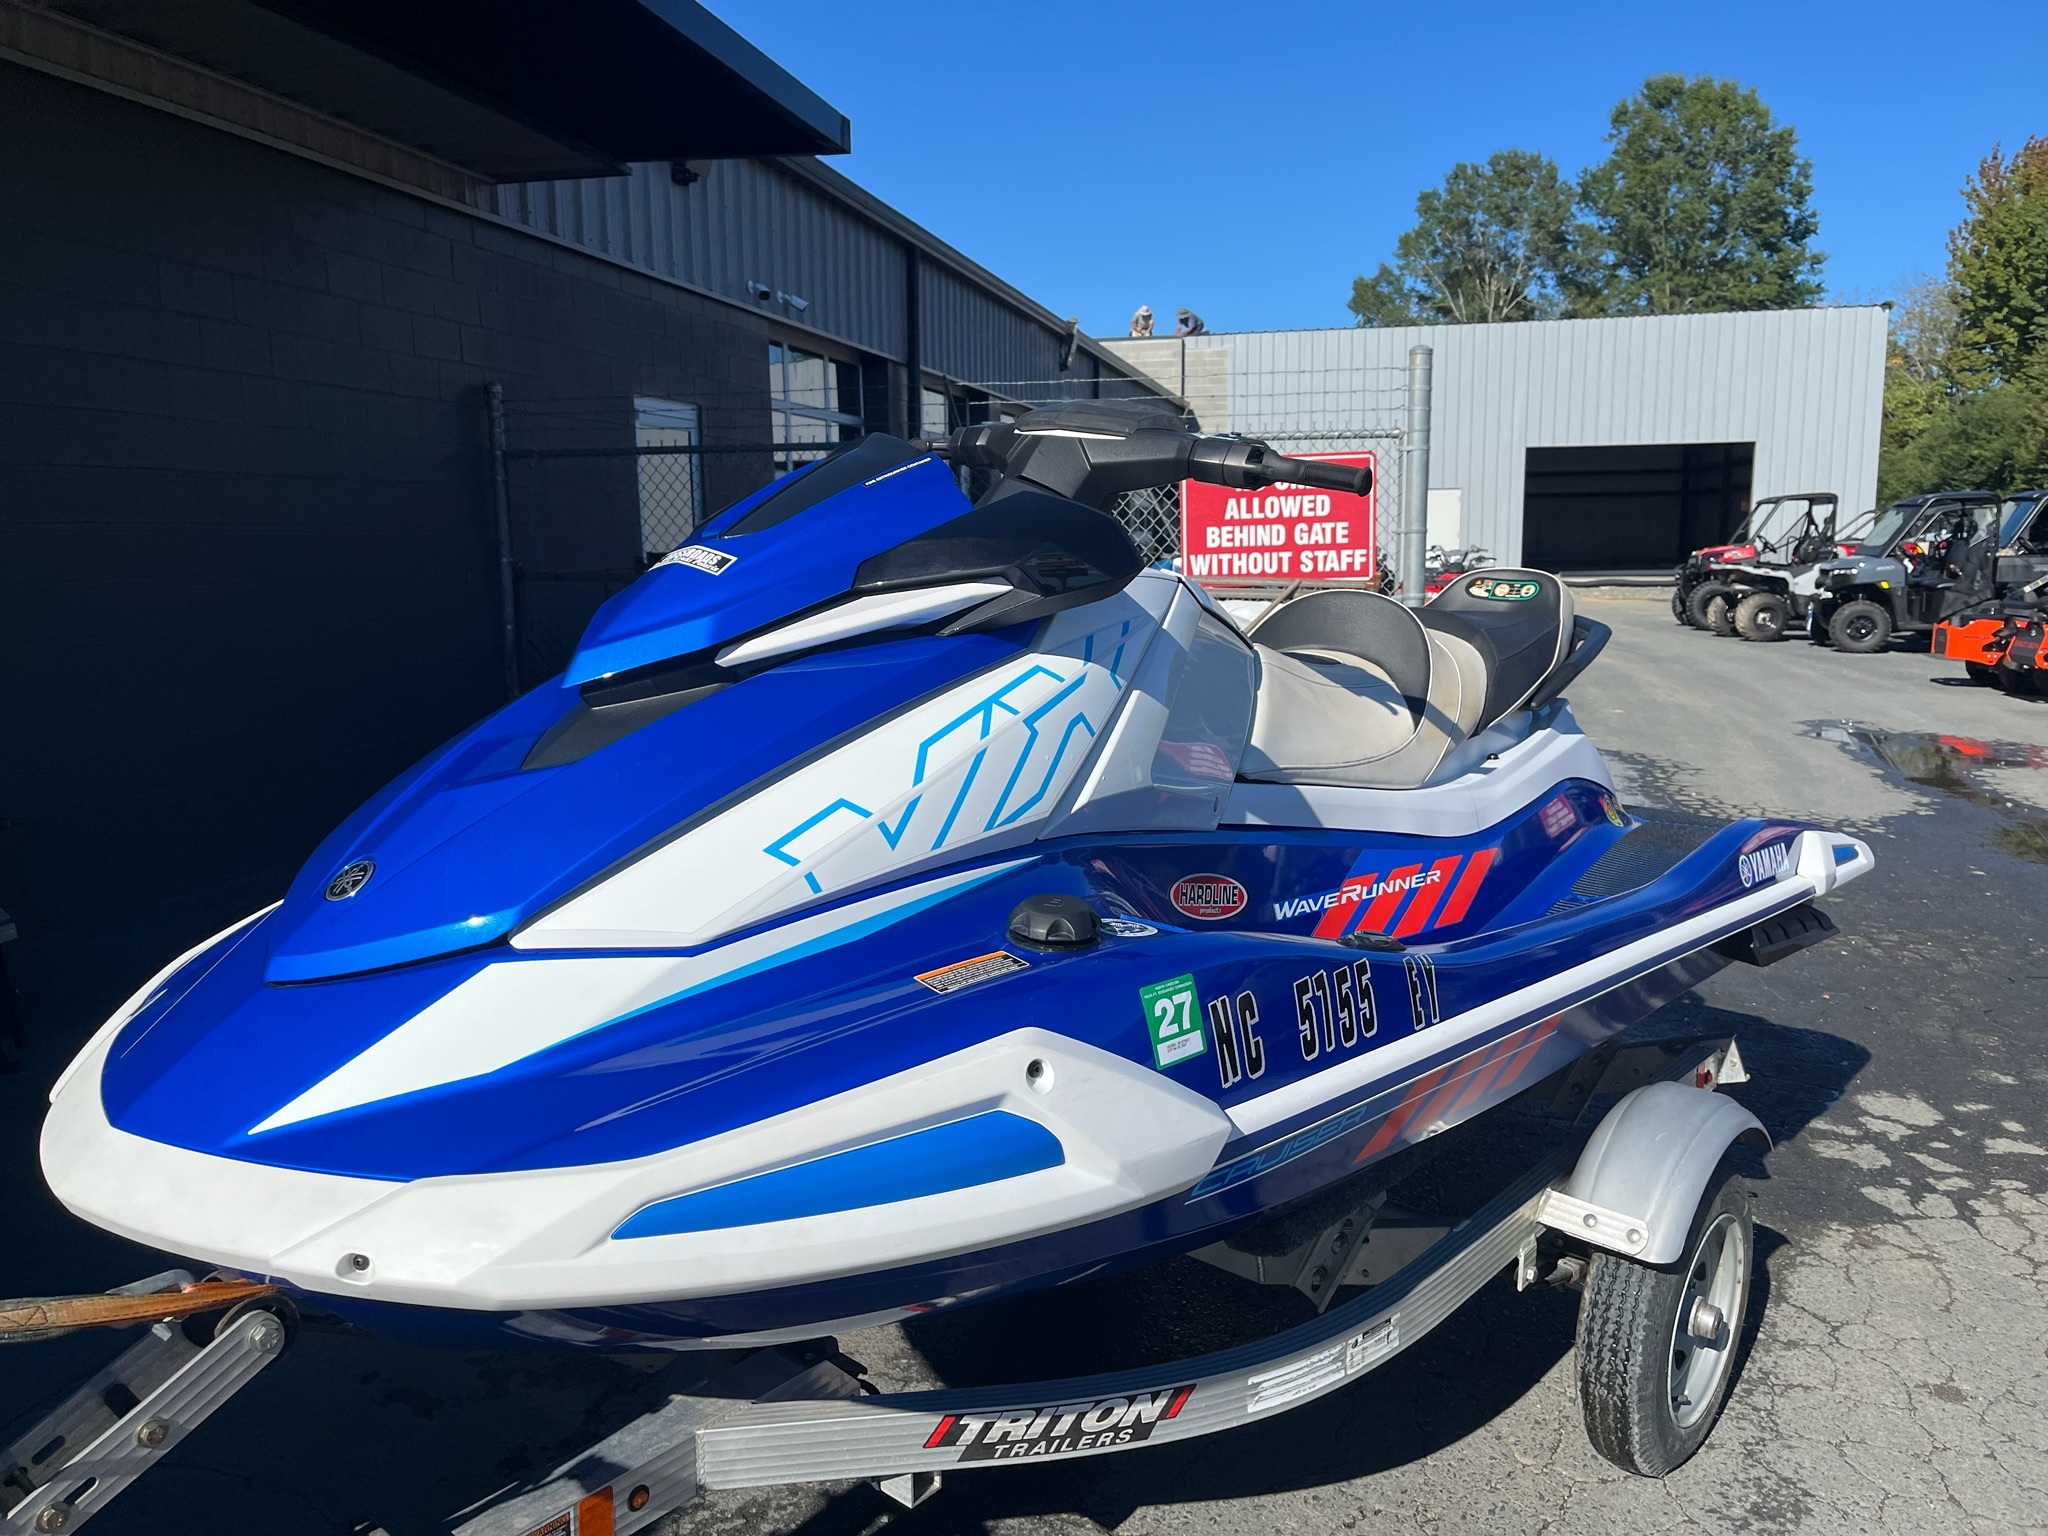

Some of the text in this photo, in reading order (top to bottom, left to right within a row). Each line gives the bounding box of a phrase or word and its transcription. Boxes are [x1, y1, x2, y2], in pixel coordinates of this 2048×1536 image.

[1224, 494, 1331, 520] ALLOWED
[1206, 522, 1349, 548] BEHIND GATE
[1189, 549, 1367, 576] WITHOUT STAFF
[1749, 842, 1790, 882] YAMAHA
[1178, 883, 1240, 906] HARDLINE
[1199, 906, 1222, 915] products
[1154, 990, 1192, 1039] 27
[1208, 953, 1440, 1089] NC 5155 EY
[1191, 1105, 1368, 1197] CRUISER
[955, 1389, 1175, 1446] TRITON
[994, 1428, 1134, 1458] TRAILERS
